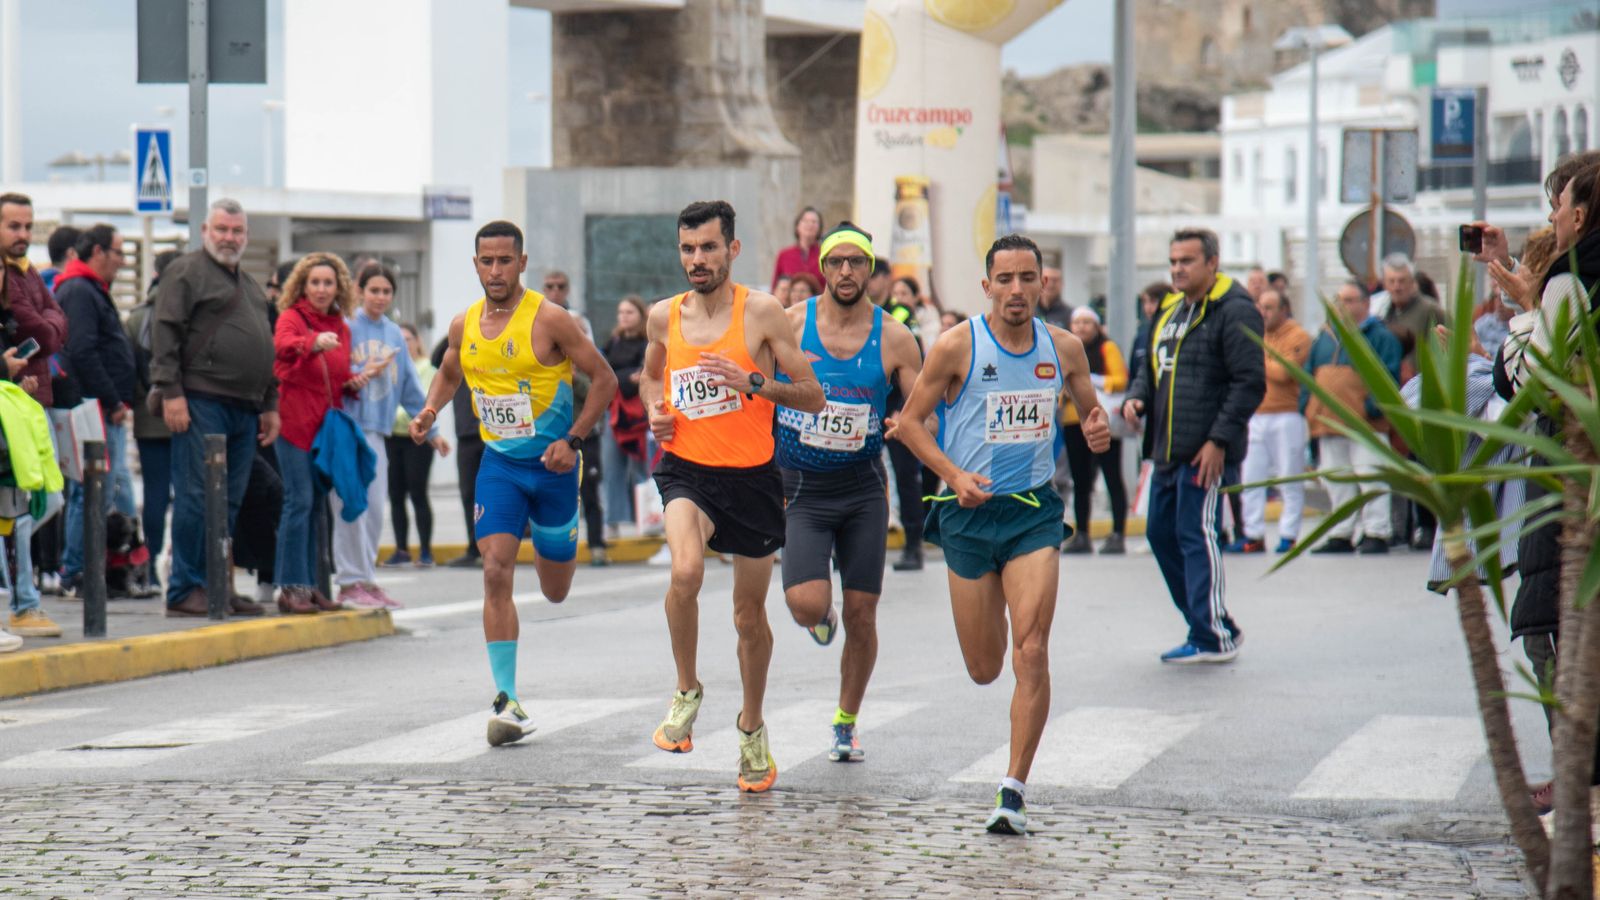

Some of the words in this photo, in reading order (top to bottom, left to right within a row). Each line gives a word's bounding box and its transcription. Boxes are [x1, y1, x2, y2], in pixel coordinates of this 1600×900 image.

[867, 107, 972, 128] Cruzcampo
[1444, 96, 1462, 127] P
[686, 378, 719, 402] 199
[1000, 394, 1020, 405] XIV
[488, 407, 516, 424] 156
[821, 413, 854, 434] 155
[1005, 403, 1039, 426] 144
